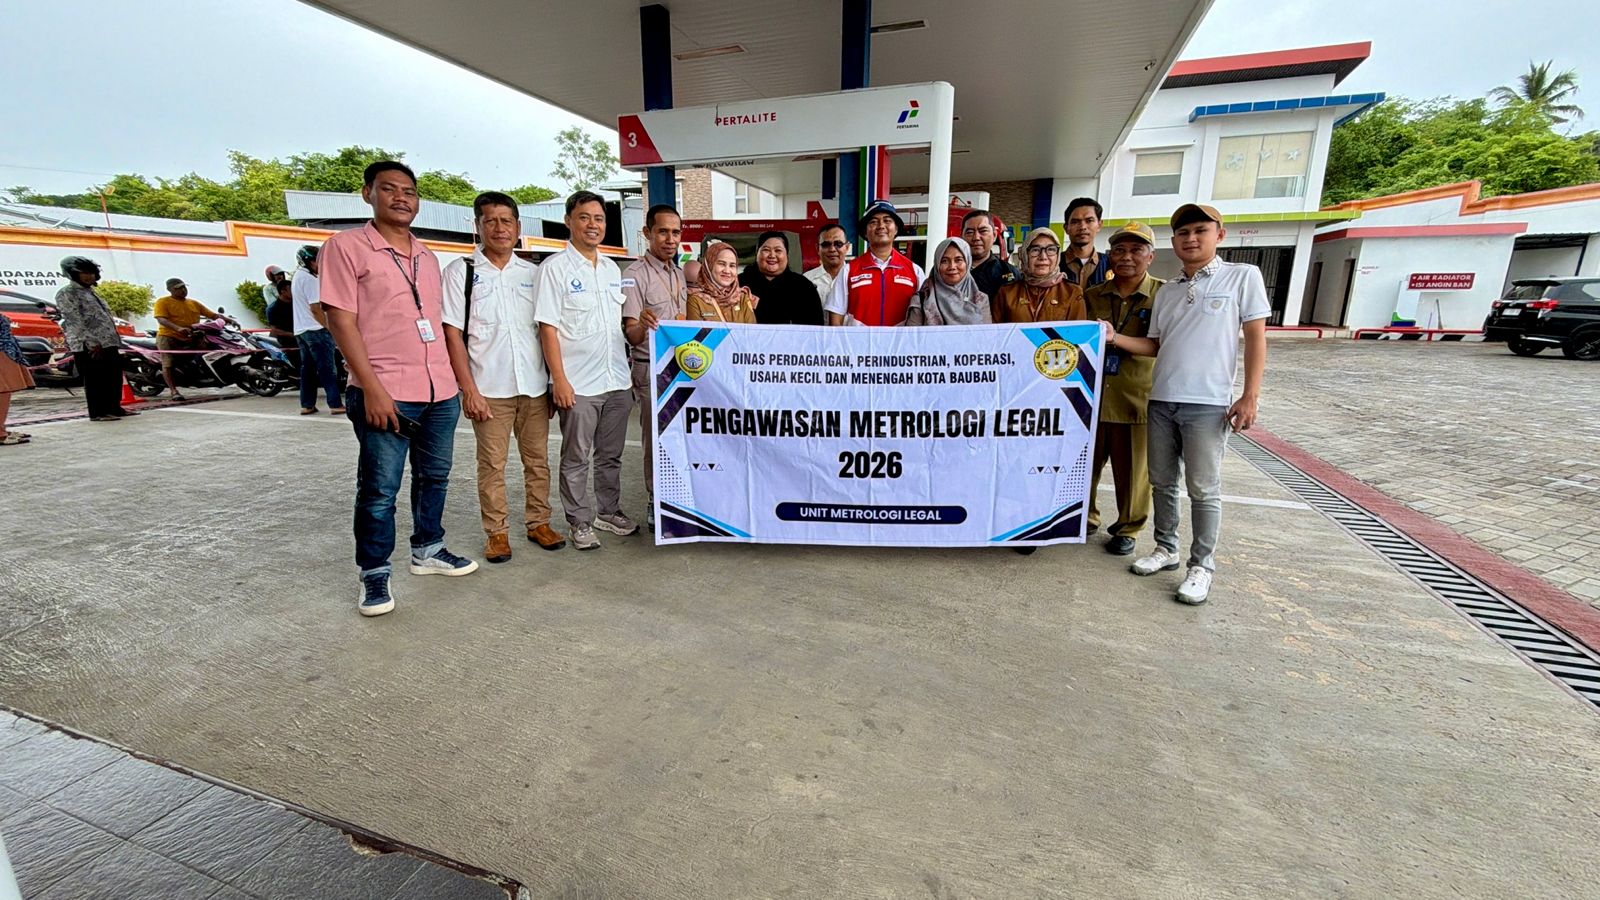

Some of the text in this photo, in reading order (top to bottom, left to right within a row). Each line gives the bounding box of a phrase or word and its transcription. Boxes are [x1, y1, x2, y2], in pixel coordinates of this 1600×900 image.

[715, 112, 777, 126] PERTALITE
[628, 132, 638, 148] 3
[812, 209, 818, 218] 4
[0, 270, 65, 278] DARAAN
[732, 352, 1015, 369] DINAS PERDAGANGAN, PERINDUSTRIAN, KOPERASI,
[750, 371, 996, 384] USAHA KECIL DAN MENENGAH KOTA BAUBAU
[685, 406, 1065, 438] PENGAWASAN METROLOGI LEGAL
[838, 451, 903, 479] 2026
[800, 507, 942, 520] UNIT METROLOGI LEGAL
